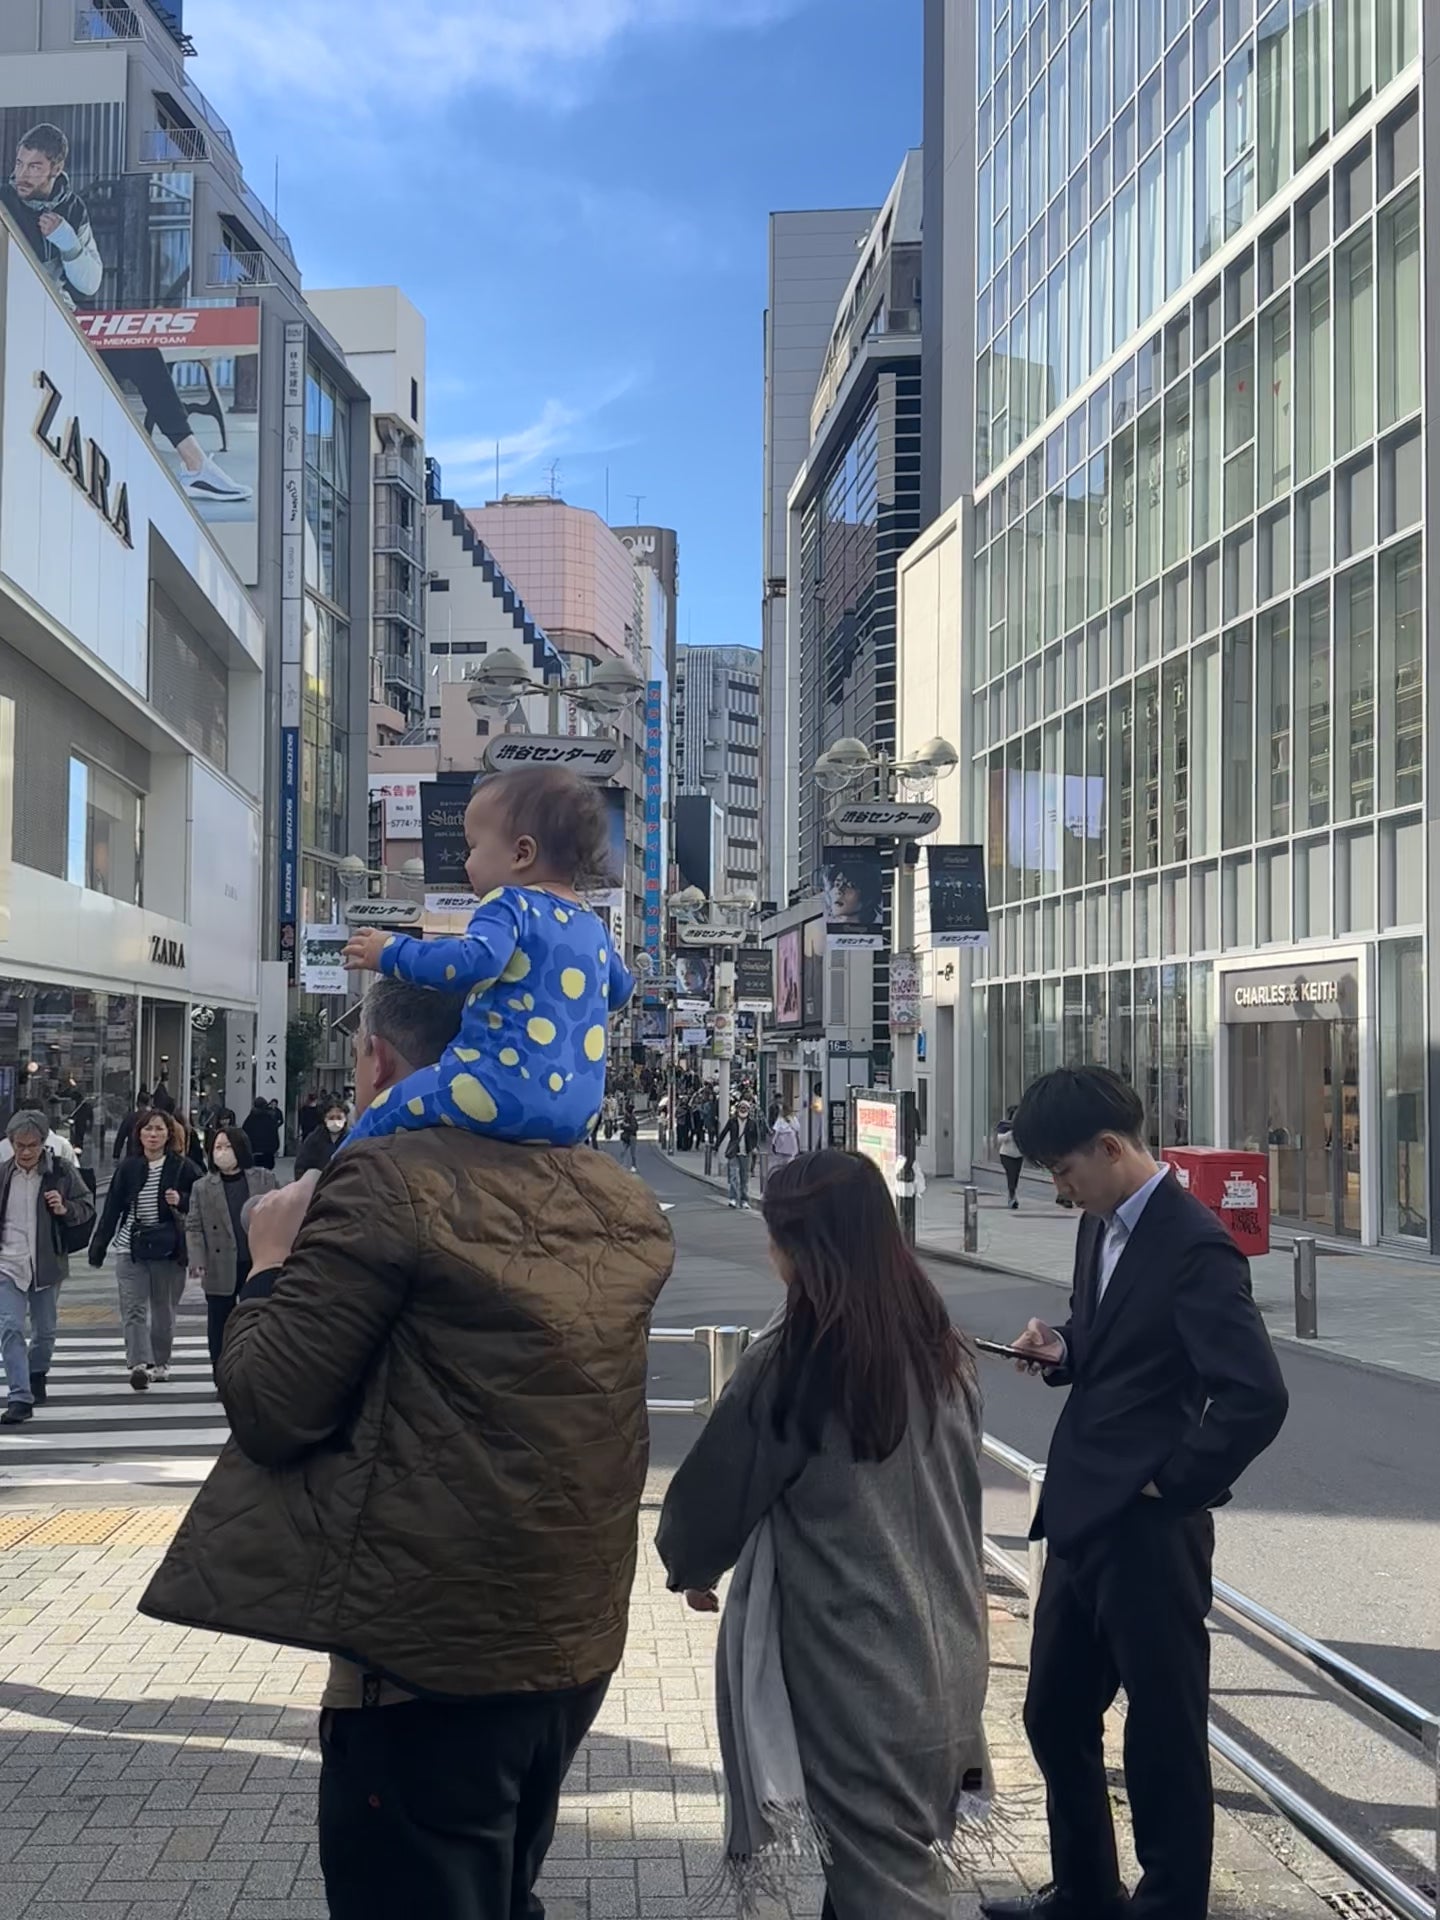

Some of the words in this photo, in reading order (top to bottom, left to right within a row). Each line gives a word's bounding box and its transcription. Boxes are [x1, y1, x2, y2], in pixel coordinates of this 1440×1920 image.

[103, 337, 151, 346] MEMORY
[153, 336, 187, 345] FOAM
[33, 370, 134, 550] ZARA
[496, 743, 617, 764] 渋谷センター街
[285, 798, 293, 851] SKECHERS
[840, 810, 935, 825] 渋谷センター街
[284, 862, 292, 915] SKECHERS
[151, 935, 186, 968] ZARA
[1234, 984, 1287, 1005] CHARLES
[1289, 983, 1299, 1002] &
[1300, 981, 1338, 1001] KEITH
[265, 1033, 278, 1085] ZARA
